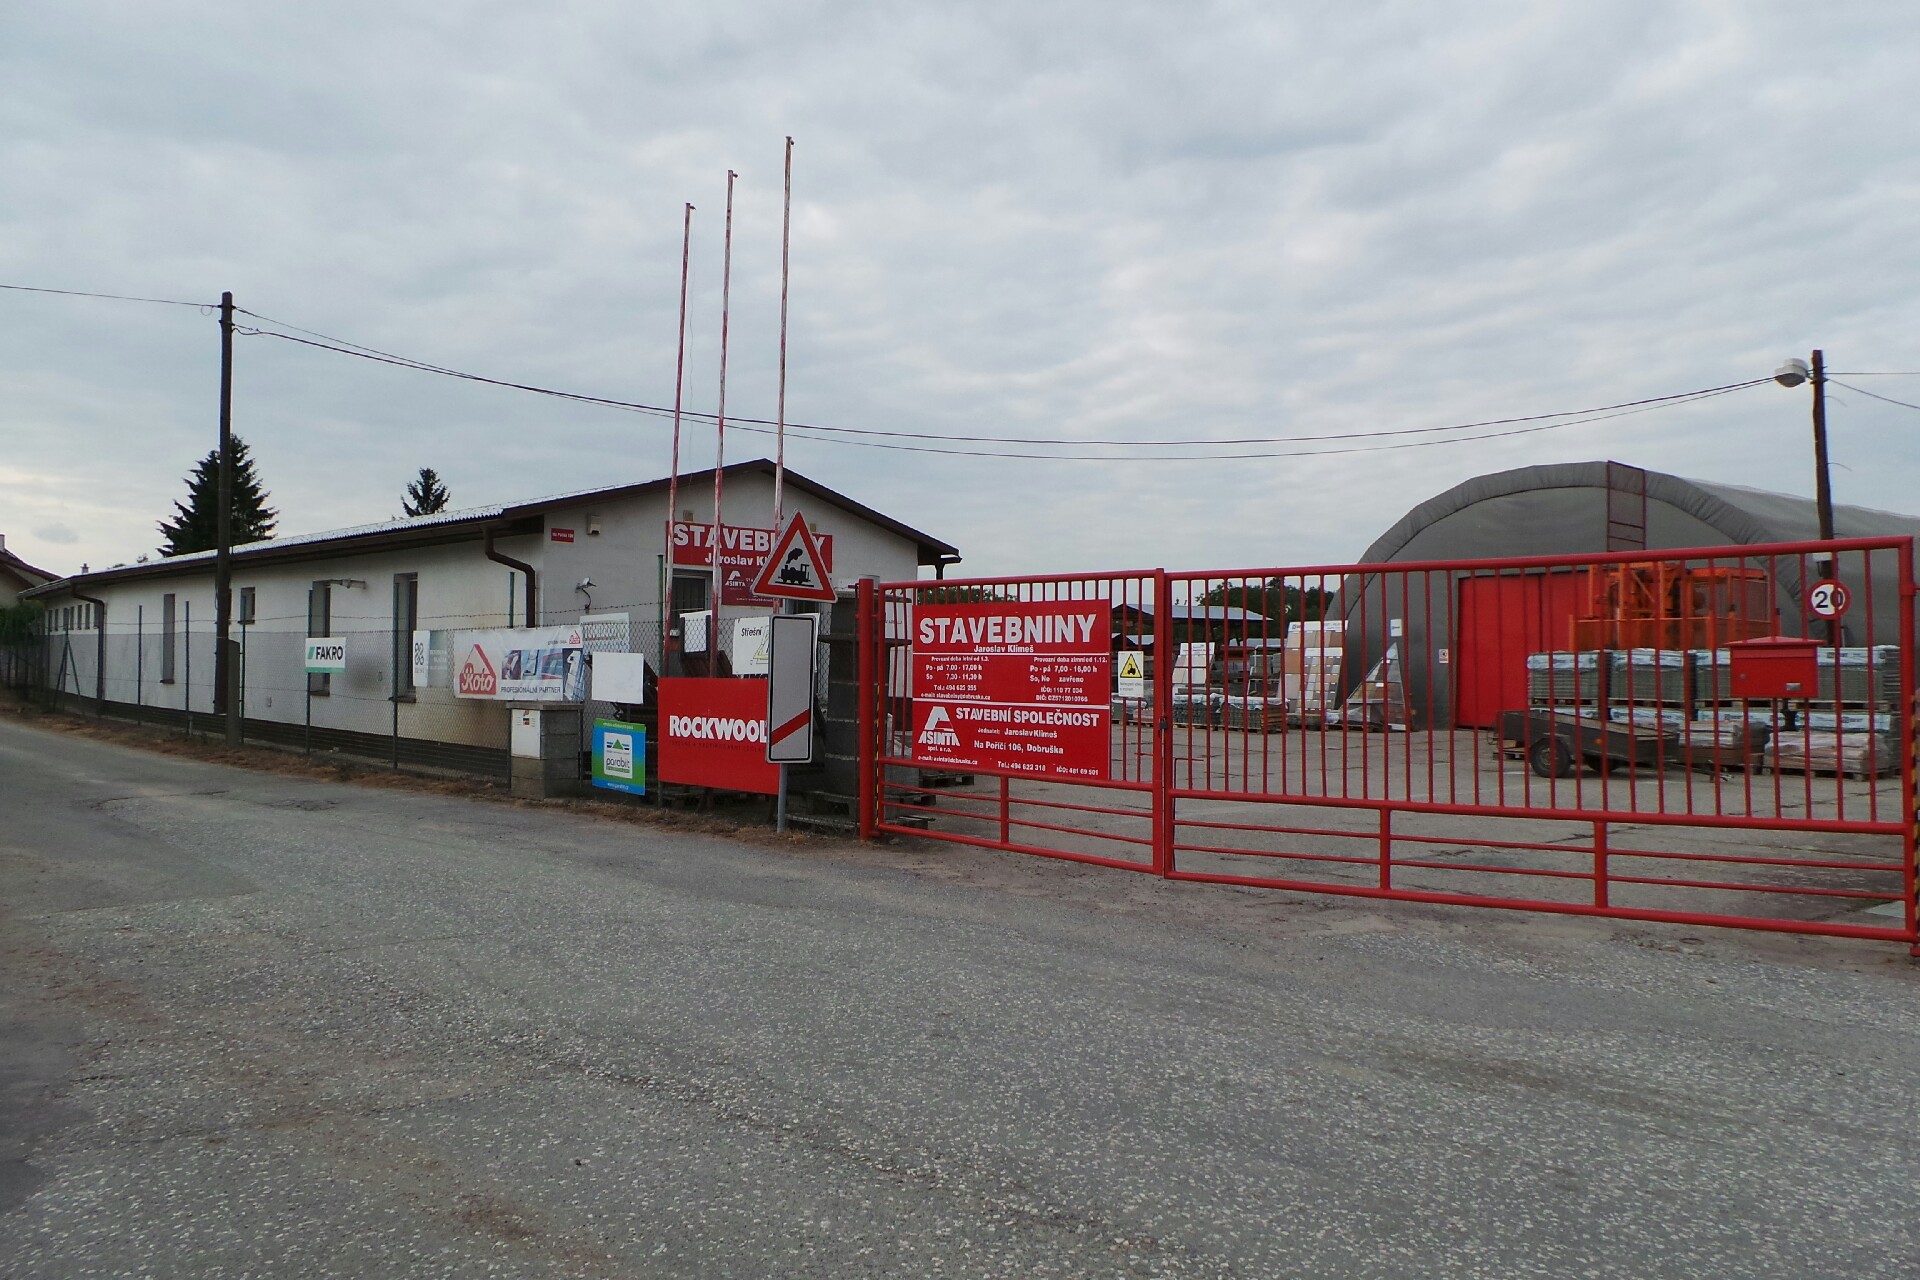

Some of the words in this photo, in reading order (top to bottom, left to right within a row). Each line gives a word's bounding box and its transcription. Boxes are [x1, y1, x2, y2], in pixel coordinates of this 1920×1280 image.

[673, 523, 825, 553] STAVEBY
[705, 552, 752, 566] Jroslav
[1815, 590, 1844, 609] 20
[919, 613, 1097, 644] STAVEBNINY
[315, 646, 344, 660] FAKRO
[973, 645, 1006, 653] Jaroslav
[1007, 644, 1034, 653] Klimeš
[538, 686, 561, 694] PARTNER
[955, 707, 1012, 722] STAVEBNÍ
[1013, 709, 1100, 727] SPOLEČNOST
[669, 715, 767, 743] ROCKWOOL
[1004, 728, 1033, 737] Jaroslav
[1033, 729, 1058, 738] Klimeš
[918, 730, 960, 746] ASINTA
[973, 740, 984, 748] Na
[985, 740, 1006, 750] Poříčí
[1026, 743, 1064, 754] Dobruška
[606, 757, 630, 769] parabit
